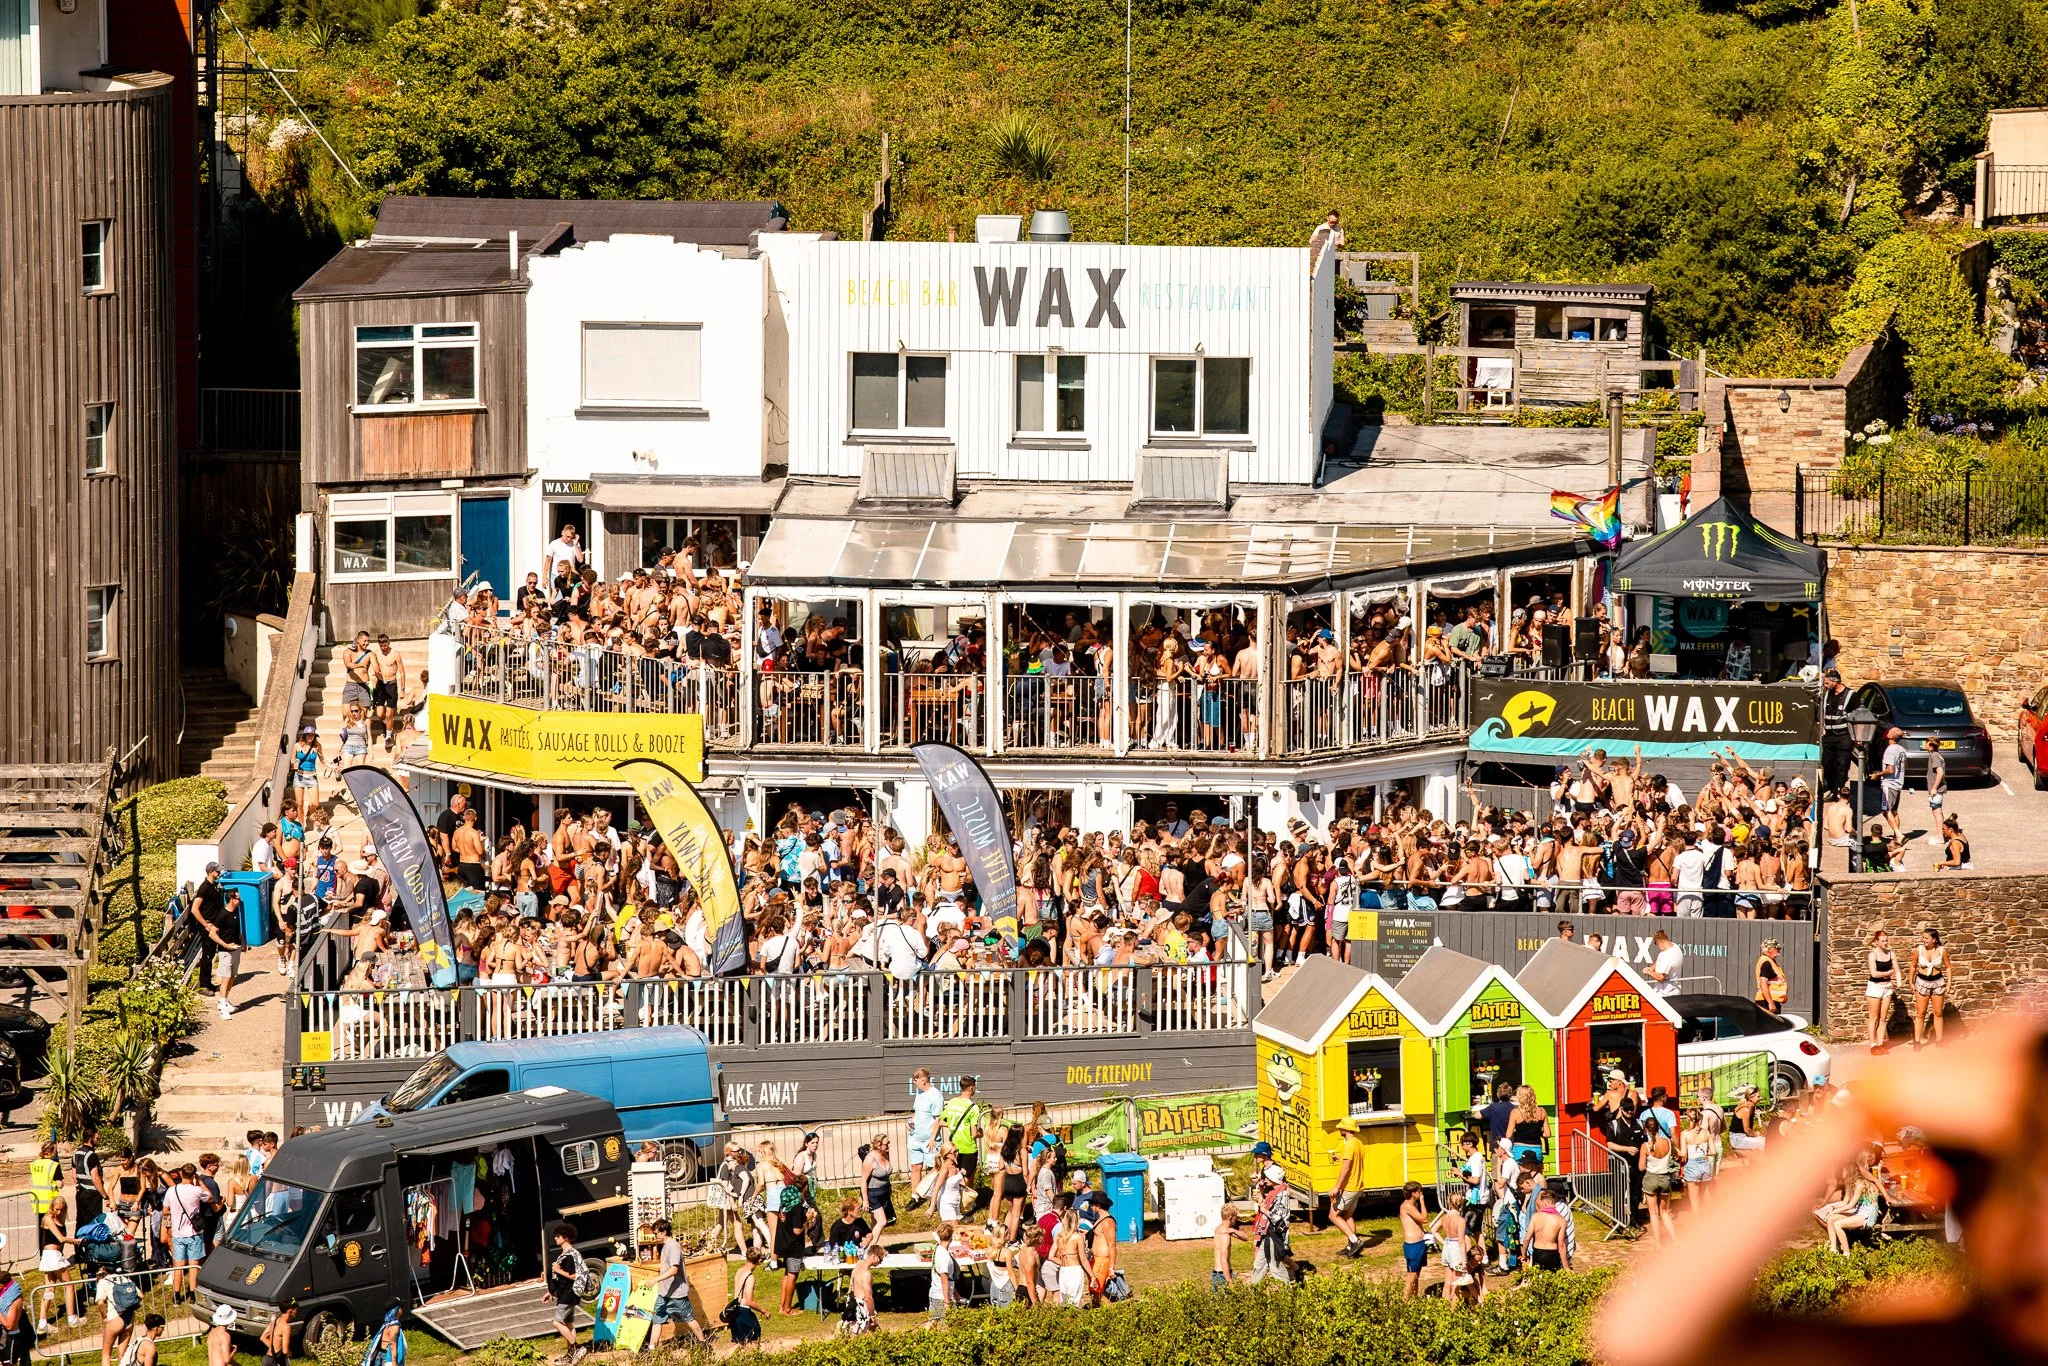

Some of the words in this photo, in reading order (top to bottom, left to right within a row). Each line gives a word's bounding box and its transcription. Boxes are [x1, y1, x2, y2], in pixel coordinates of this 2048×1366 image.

[848, 279, 909, 307] BEACH
[922, 280, 958, 308] BAR
[973, 266, 1127, 329] WAX
[1142, 283, 1271, 312] RESTAURANT
[545, 482, 570, 493] WAX
[570, 482, 590, 494] SHACK
[343, 557, 369, 569] WAX
[1683, 578, 1752, 592] MONSTER
[1592, 698, 1635, 722] BEACH
[1644, 695, 1741, 733] WAX
[1749, 701, 1784, 725] CLUB
[442, 713, 492, 752] WAX
[500, 727, 534, 752] PASTIES,
[538, 732, 589, 752] SAUSAGE
[594, 733, 628, 752] ROLLS
[633, 734, 644, 753] &
[649, 734, 685, 754] BOOZE
[1394, 919, 1416, 928] WAX
[1411, 929, 1428, 937] TIMES
[1674, 944, 1729, 957] STAURANT
[1471, 1001, 1521, 1022] RATTLER
[1592, 993, 1641, 1013] RATTLER
[1349, 1009, 1399, 1030] RATTLER
[908, 1077, 935, 1095] LE
[940, 1074, 980, 1094] MUC
[1066, 1066, 1092, 1085] DOG
[1095, 1063, 1152, 1084] FRIENDLY
[724, 1083, 754, 1107] AKE
[760, 1081, 799, 1106] AWAY
[1143, 1103, 1224, 1136] RATTLER
[1143, 1138, 1175, 1149] CORNISH
[1175, 1135, 1203, 1146] CLOUDY
[1262, 1105, 1310, 1166] RATTLER
